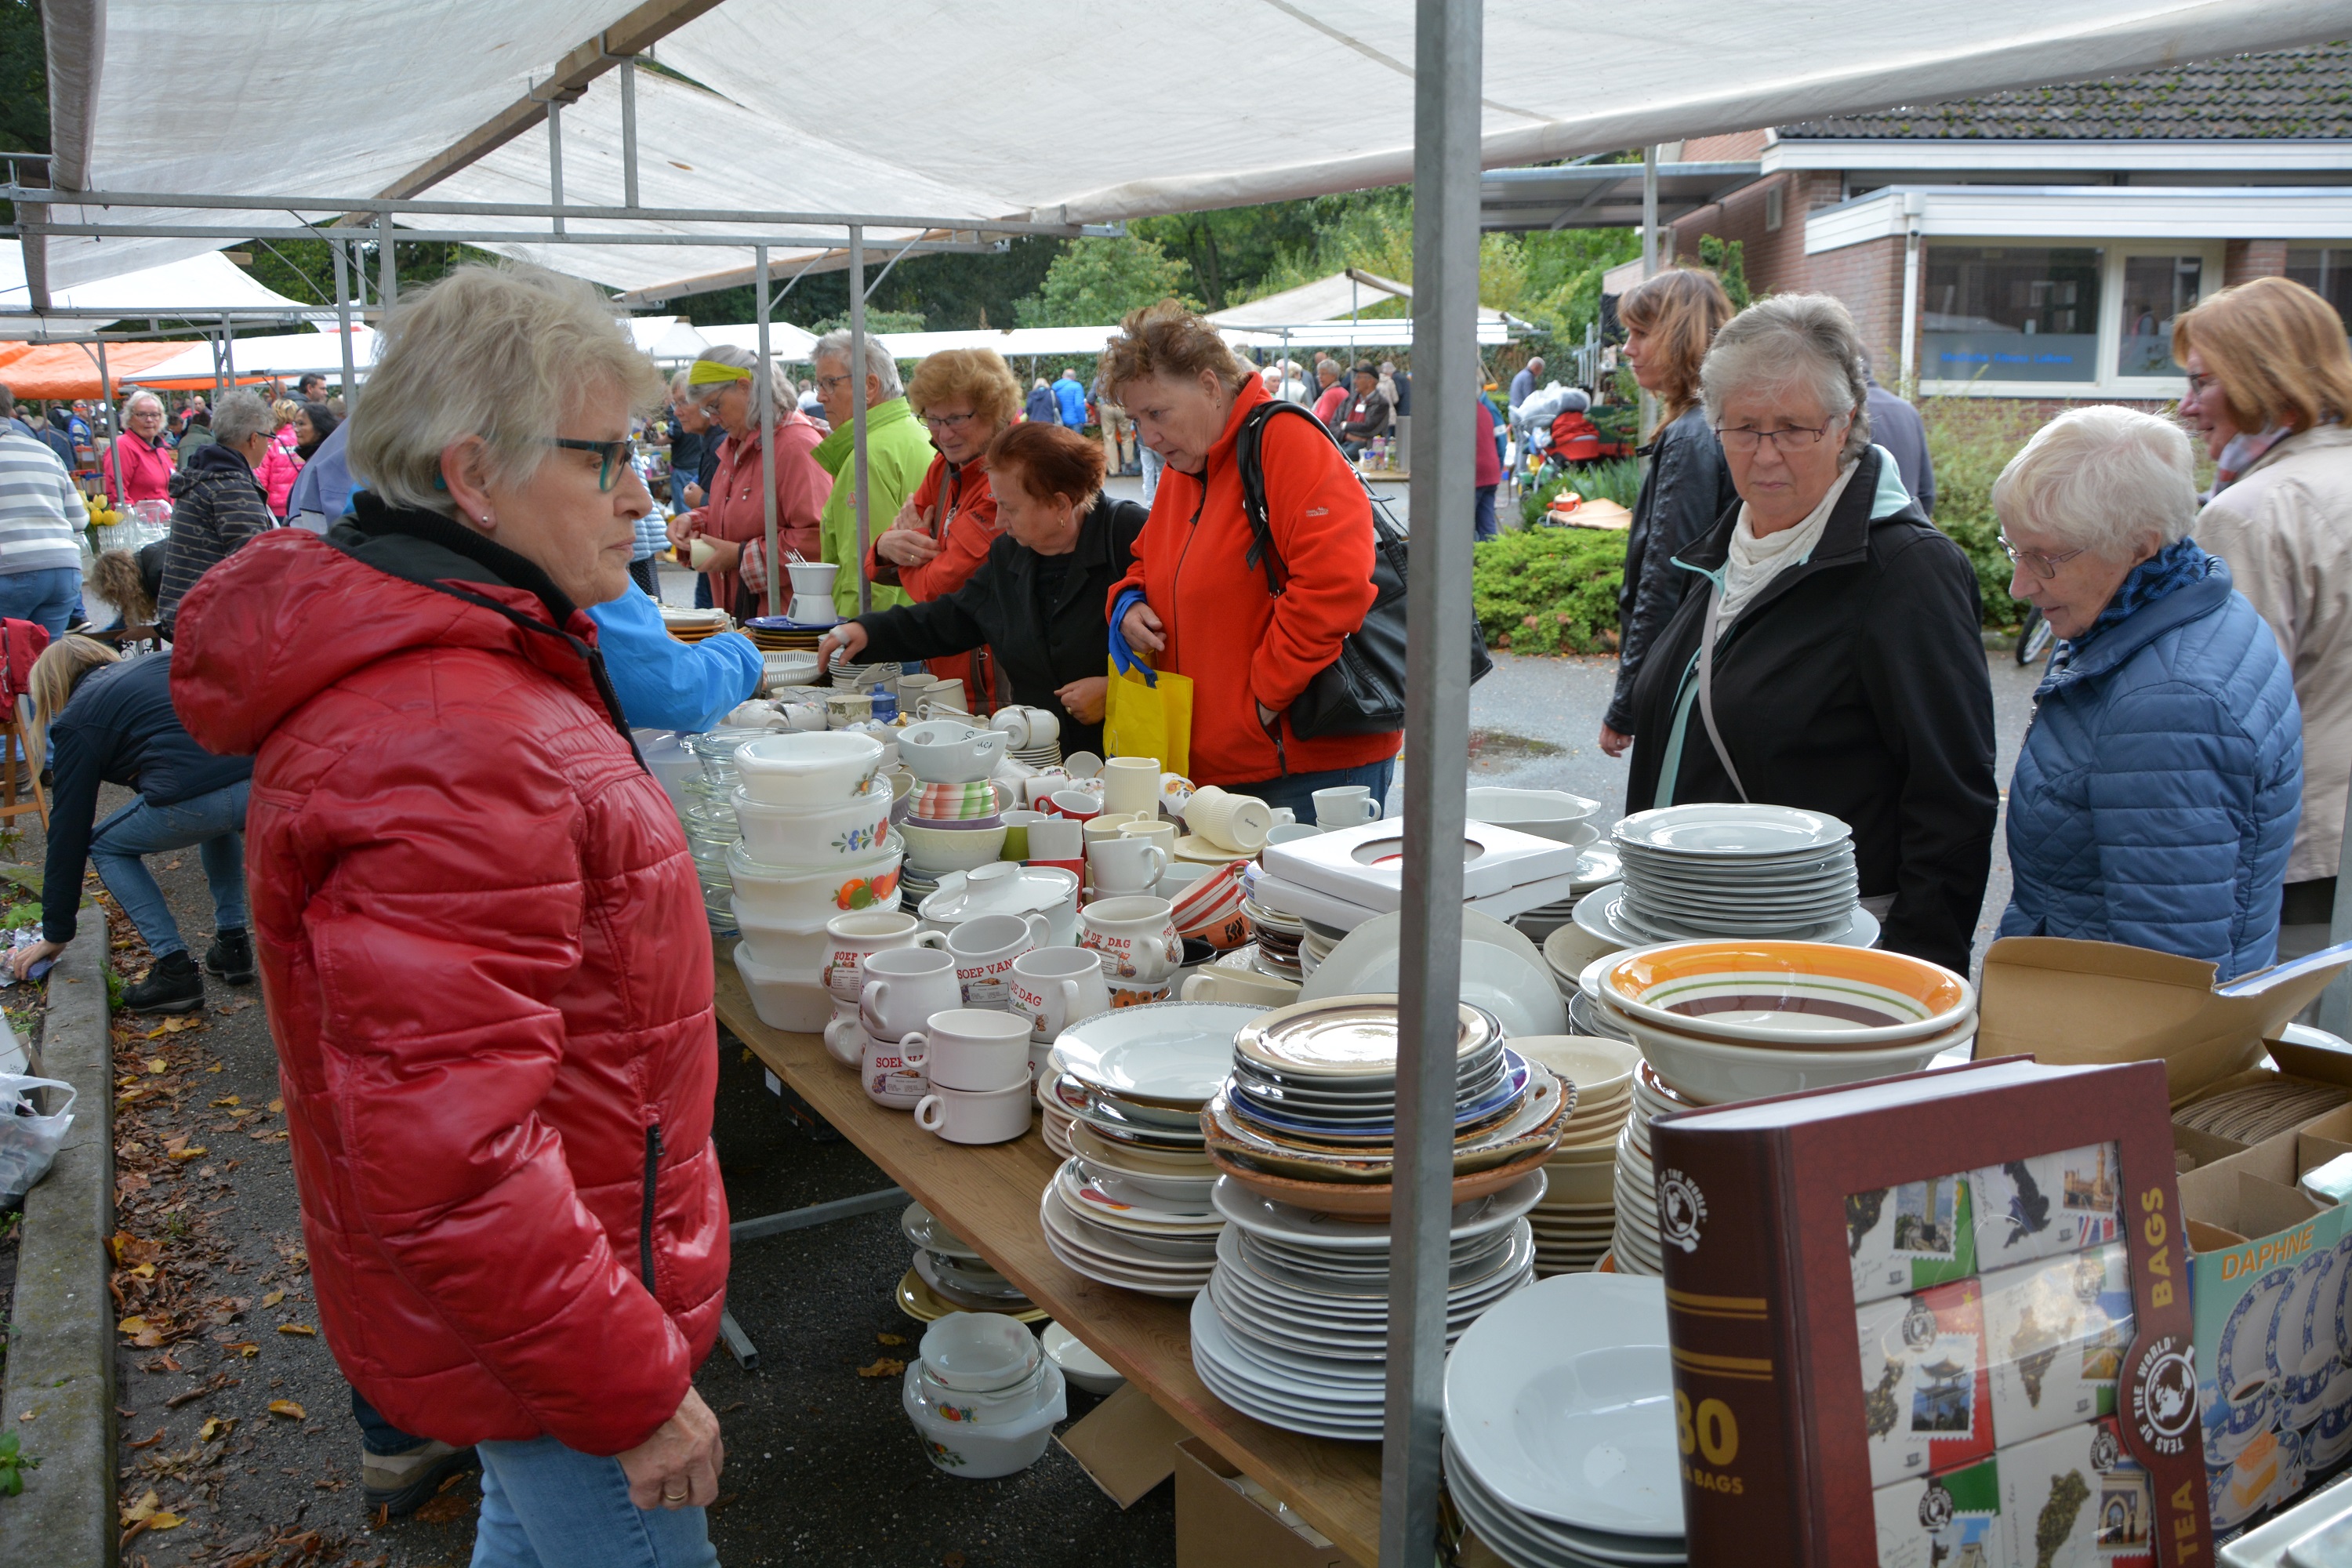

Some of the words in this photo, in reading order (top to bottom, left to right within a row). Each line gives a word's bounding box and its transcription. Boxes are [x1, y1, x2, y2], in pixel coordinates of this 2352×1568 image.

[1091, 932, 1103, 944] DE
[1108, 937, 1131, 949] DAG
[834, 951, 858, 961] SOEP
[956, 967, 985, 980] SOEP
[986, 959, 1013, 975] VAN
[1011, 979, 1019, 995] DE
[1018, 989, 1042, 1007] DAG
[1686, 1177, 1708, 1214] WORLD
[2141, 1187, 2173, 1308] BAGS
[2222, 1225, 2315, 1282] DAPHNE
[2137, 1337, 2171, 1378] WORLD
[2133, 1385, 2145, 1420] THE
[2139, 1423, 2154, 1444] OF
[2155, 1436, 2185, 1454] TEAS
[1693, 1468, 1744, 1495] BAGS
[2171, 1479, 2198, 1566] TEA
